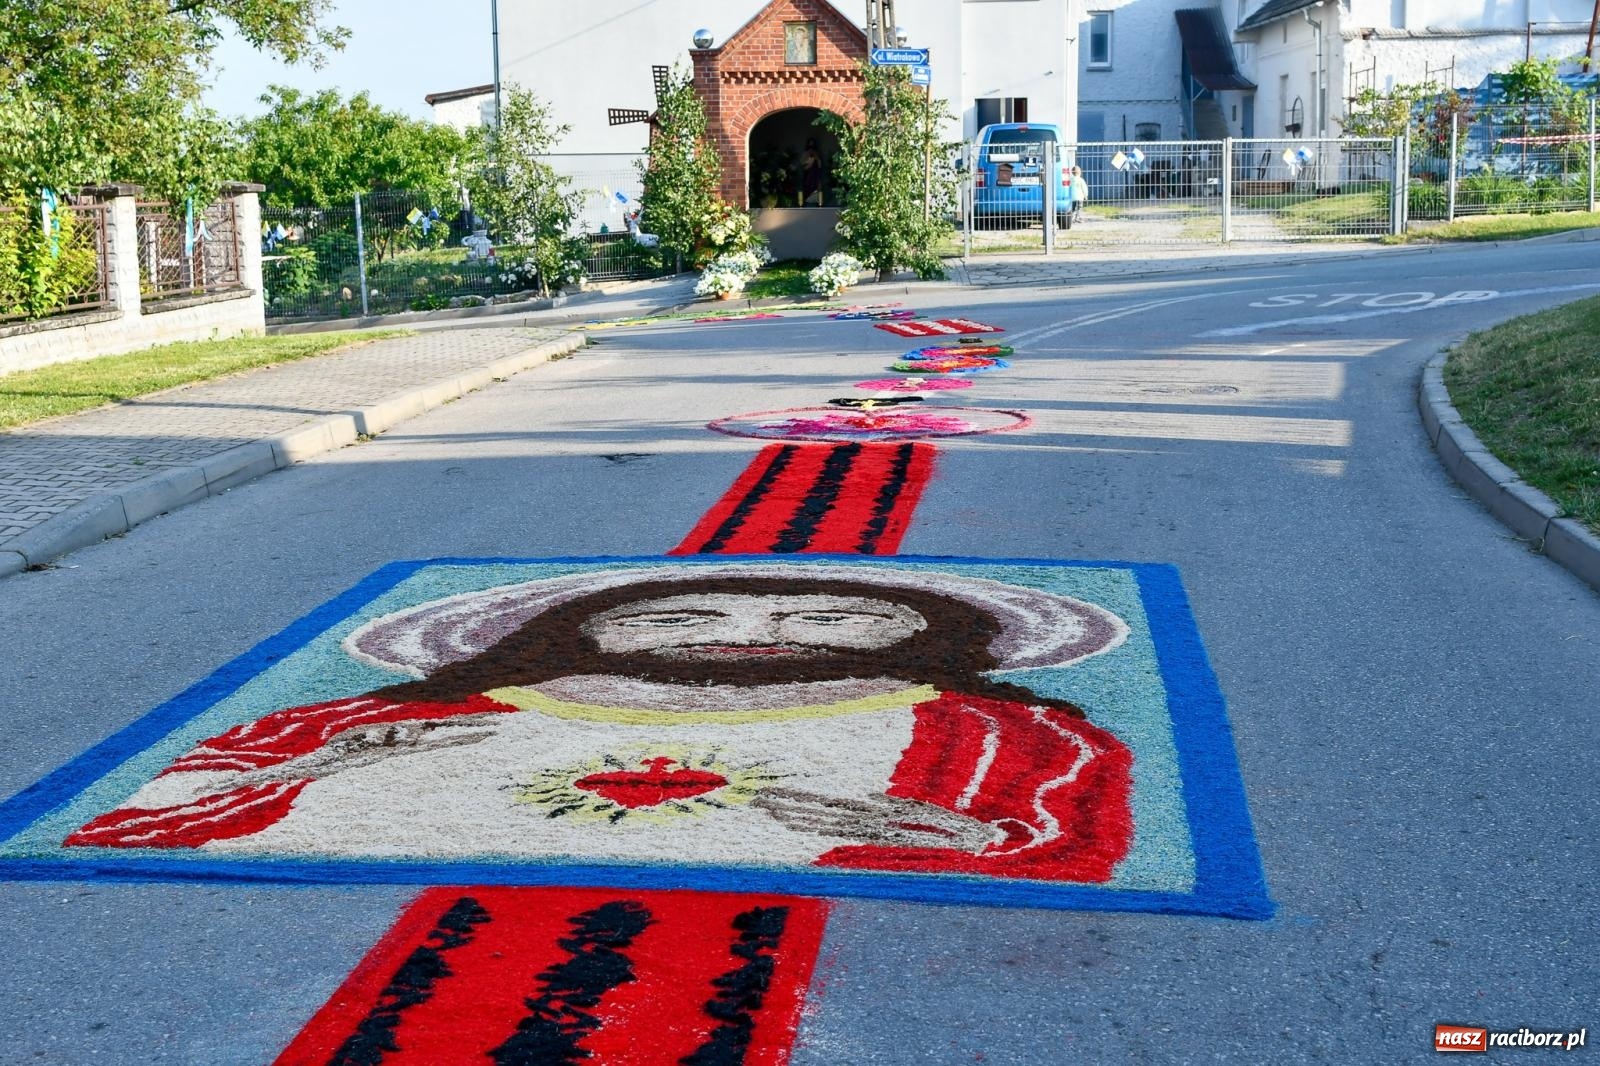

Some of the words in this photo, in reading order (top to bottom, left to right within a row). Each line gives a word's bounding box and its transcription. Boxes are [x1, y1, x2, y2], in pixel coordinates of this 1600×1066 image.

[877, 52, 886, 61] ul.
[886, 52, 921, 62] Wiatrakowa
[1249, 290, 1499, 308] STOP
